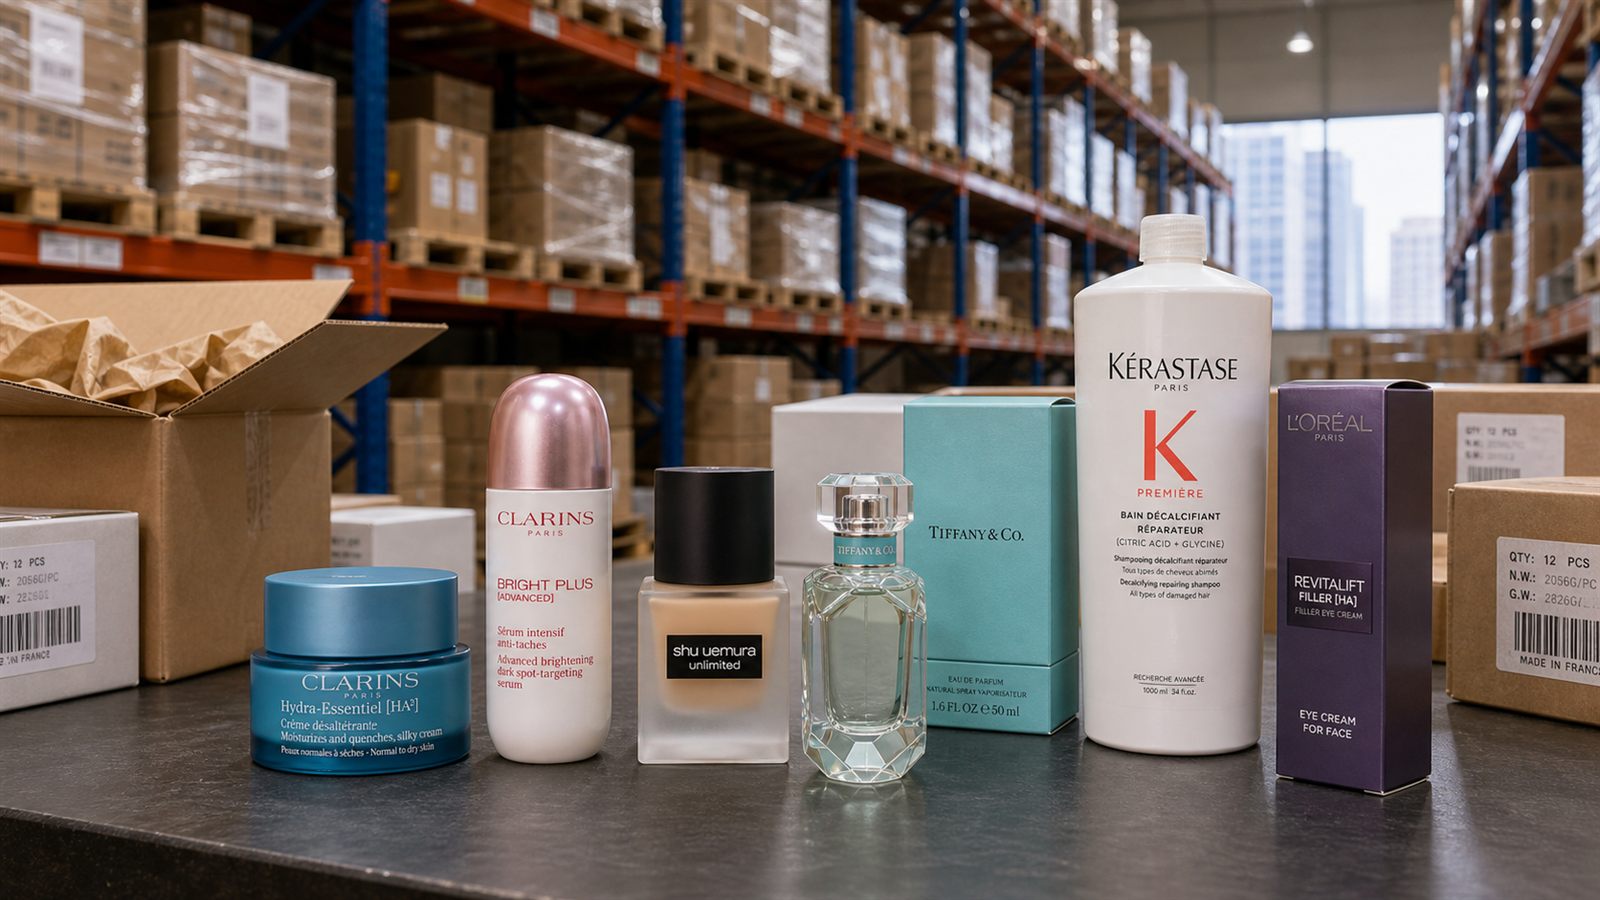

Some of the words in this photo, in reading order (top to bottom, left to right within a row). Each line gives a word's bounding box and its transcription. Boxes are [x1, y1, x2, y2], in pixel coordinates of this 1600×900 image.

[1109, 352, 1238, 380] KÉRASTASE
[1288, 411, 1373, 432] L'ORÉAL
[1314, 434, 1344, 442] PARIS
[1144, 410, 1198, 481] K
[1137, 487, 1203, 498] PREMIÈRE
[497, 511, 594, 526] CLARINS
[1121, 511, 1143, 519] BAIN
[1147, 510, 1221, 520] DÉCALCIFIANT
[1137, 524, 1204, 534] RÉPARATEUR
[1116, 538, 1146, 547] (CITRIC
[1149, 540, 1171, 548] ACID
[1182, 540, 1224, 548] GLYCINE)
[837, 546, 873, 555] TIFFANY
[14, 559, 22, 569] 12
[29, 557, 45, 567] PCS
[1510, 551, 1534, 564] QTY:
[1544, 555, 1556, 565] 12
[1568, 557, 1590, 568] PCS
[1510, 570, 1535, 582] N.W.:
[497, 578, 550, 591] BRIGHT
[555, 578, 593, 590] PLUS
[1294, 575, 1365, 593] REVITALIFT
[497, 593, 554, 603] [ADVANCED]
[1166, 592, 1196, 600] damaged
[1299, 591, 1332, 604] FILLER
[1335, 594, 1357, 608] [HA]
[1509, 588, 1535, 601] G.W.:
[1322, 609, 1335, 617] EYE
[1337, 610, 1363, 620] CREAM
[497, 626, 524, 637] Sérum
[527, 627, 565, 637] intensif
[497, 639, 547, 650] anti-taches
[673, 644, 699, 657] shu
[702, 646, 756, 657] uemura
[497, 655, 538, 666] Advanced
[541, 655, 594, 668] brightening
[689, 660, 741, 670] unlimited
[1520, 656, 1546, 668] MADE
[1551, 660, 1561, 669] IN
[1565, 662, 1600, 675] FRANC
[497, 666, 514, 676] dark
[516, 668, 583, 680] spot-targeting
[302, 672, 419, 691] CLARINS
[497, 679, 523, 689] serum
[975, 677, 1004, 685] PARFUM
[281, 700, 381, 715] Hydra-Essentiel
[932, 701, 945, 711] 1.6
[947, 702, 960, 712] FL
[962, 703, 978, 714] OZ
[991, 705, 1004, 715] 50
[1006, 706, 1020, 716] ml
[1300, 709, 1318, 720] EYE
[1320, 712, 1356, 726] CREAM
[1303, 723, 1323, 735] FOR
[1326, 727, 1352, 739] FACE
[328, 733, 346, 743] and
[349, 733, 396, 746] quenches,
[397, 730, 418, 741] silky
[370, 746, 397, 756] Normal
[407, 745, 418, 754] dry
